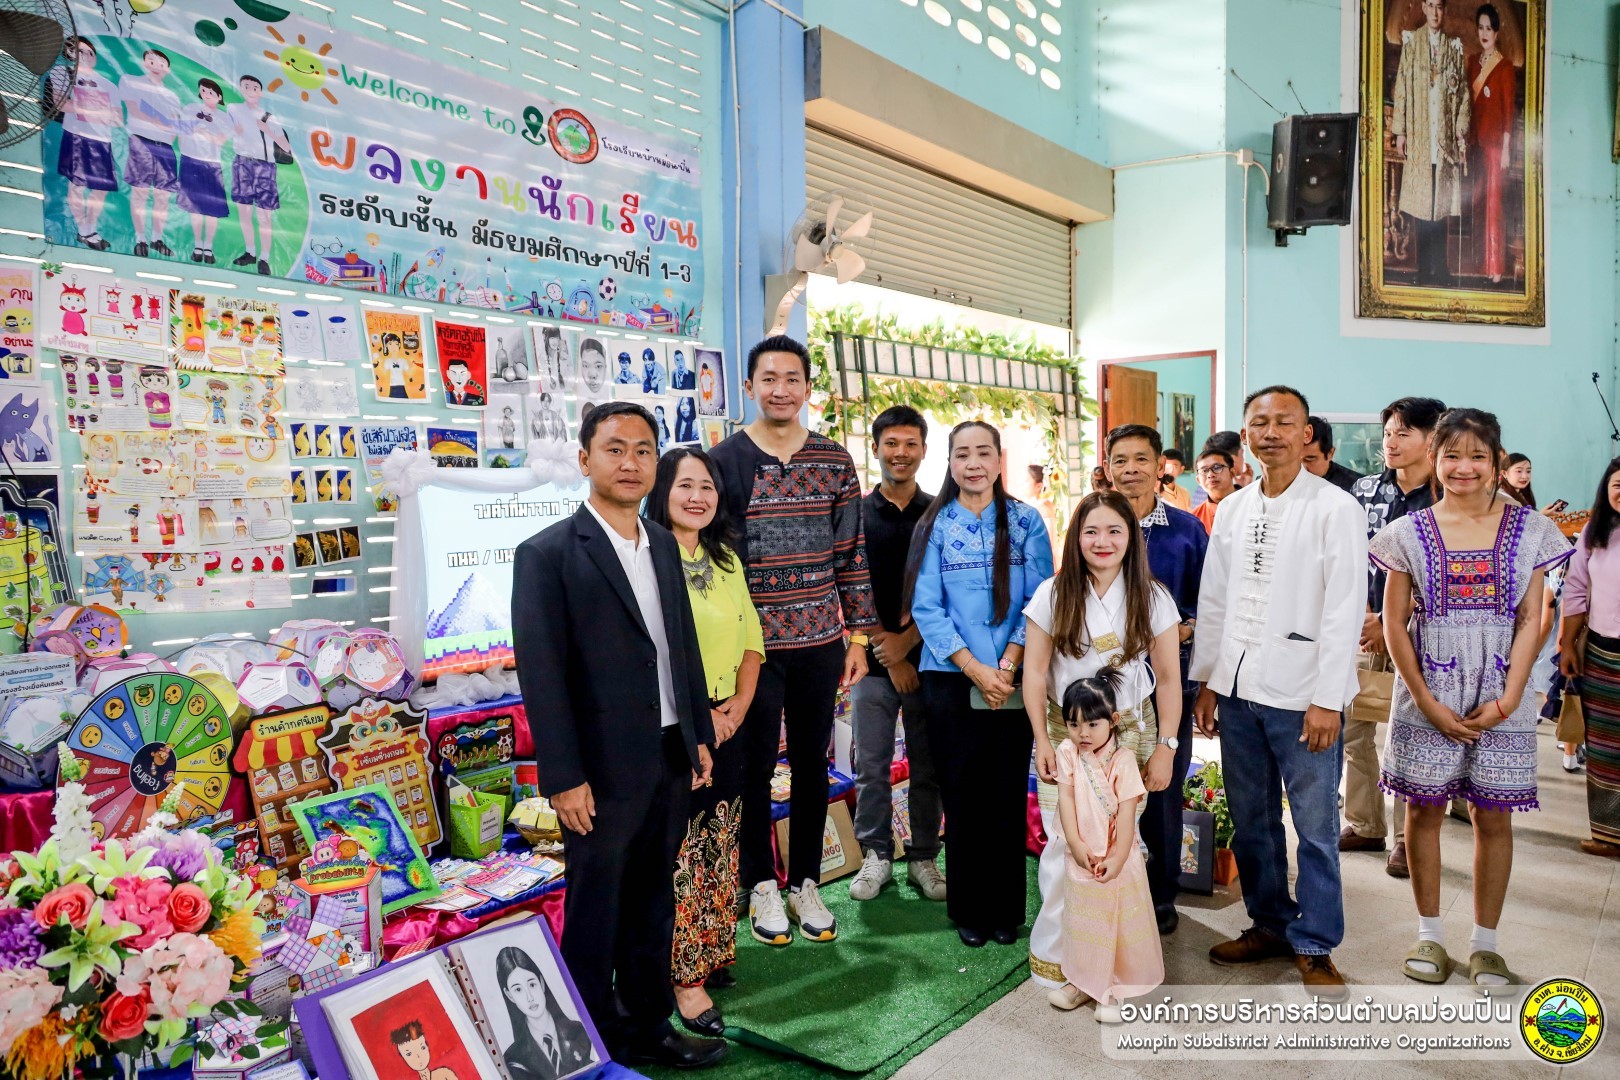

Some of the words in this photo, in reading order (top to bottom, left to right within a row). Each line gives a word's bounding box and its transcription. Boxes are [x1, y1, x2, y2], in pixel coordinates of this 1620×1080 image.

[340, 63, 471, 121] Welcome
[482, 106, 516, 135] to
[310, 130, 698, 248] ผลงานนักเรียน
[318, 193, 457, 238] ระดับชั้น
[471, 220, 650, 277] มัธยมศึกษาปีที่
[659, 262, 692, 283] 1-3
[10, 288, 33, 304] คุณ
[132, 764, 161, 791] feeling
[310, 868, 364, 882] probability
